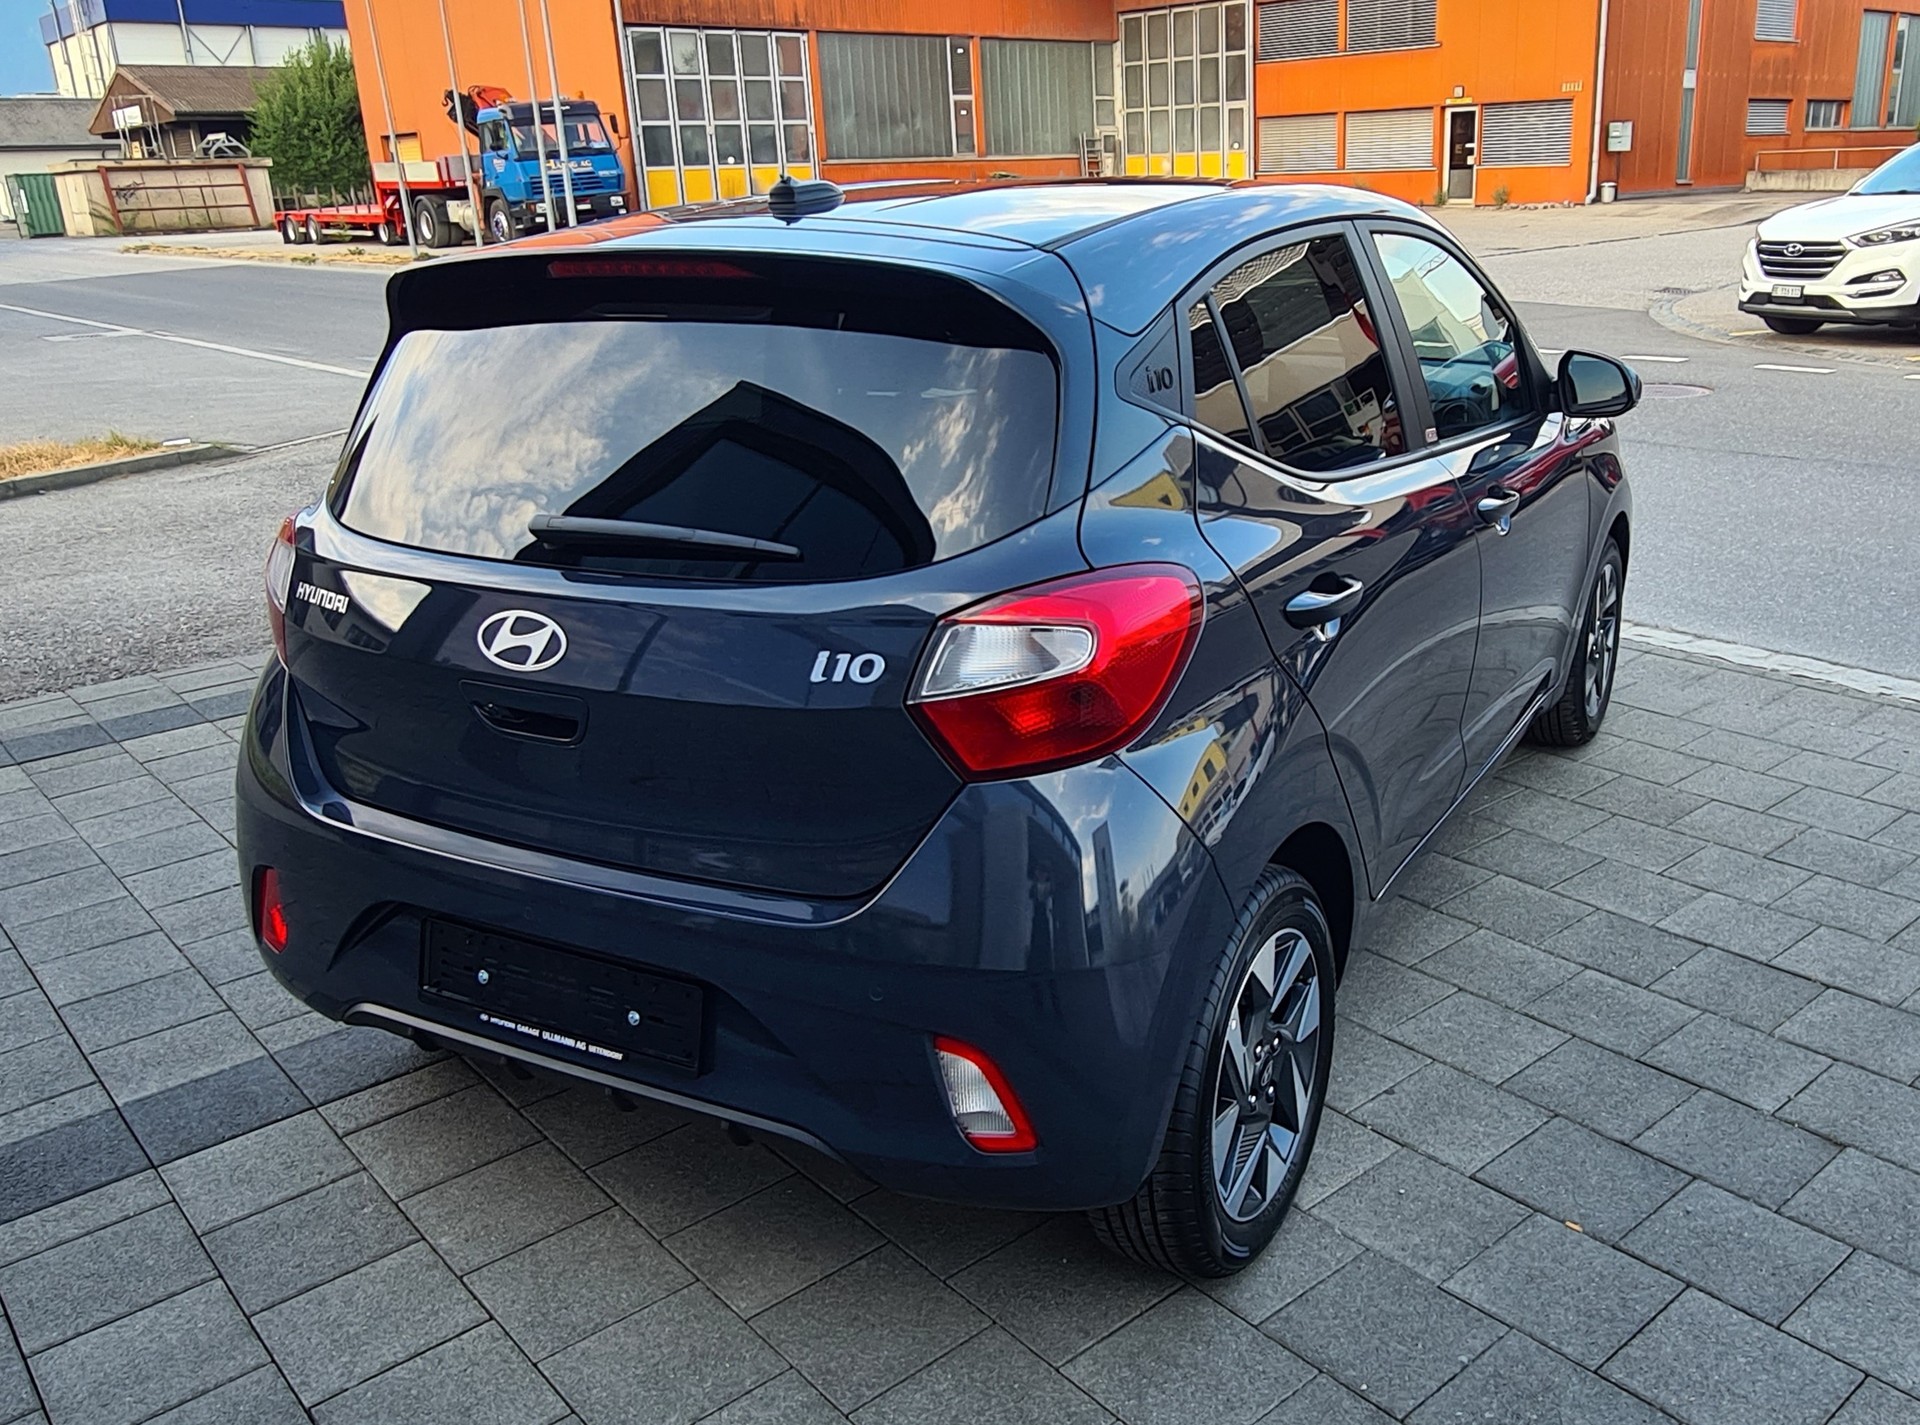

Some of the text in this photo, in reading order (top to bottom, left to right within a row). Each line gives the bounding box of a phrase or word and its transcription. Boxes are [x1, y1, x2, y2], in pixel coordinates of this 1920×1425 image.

[1146, 366, 1173, 393] i10
[296, 581, 349, 614] HYUNDAI
[810, 651, 886, 683] i10
[517, 1024, 540, 1037] GARAGE
[542, 1031, 576, 1047] ULLMANN
[575, 1041, 587, 1051] AG
